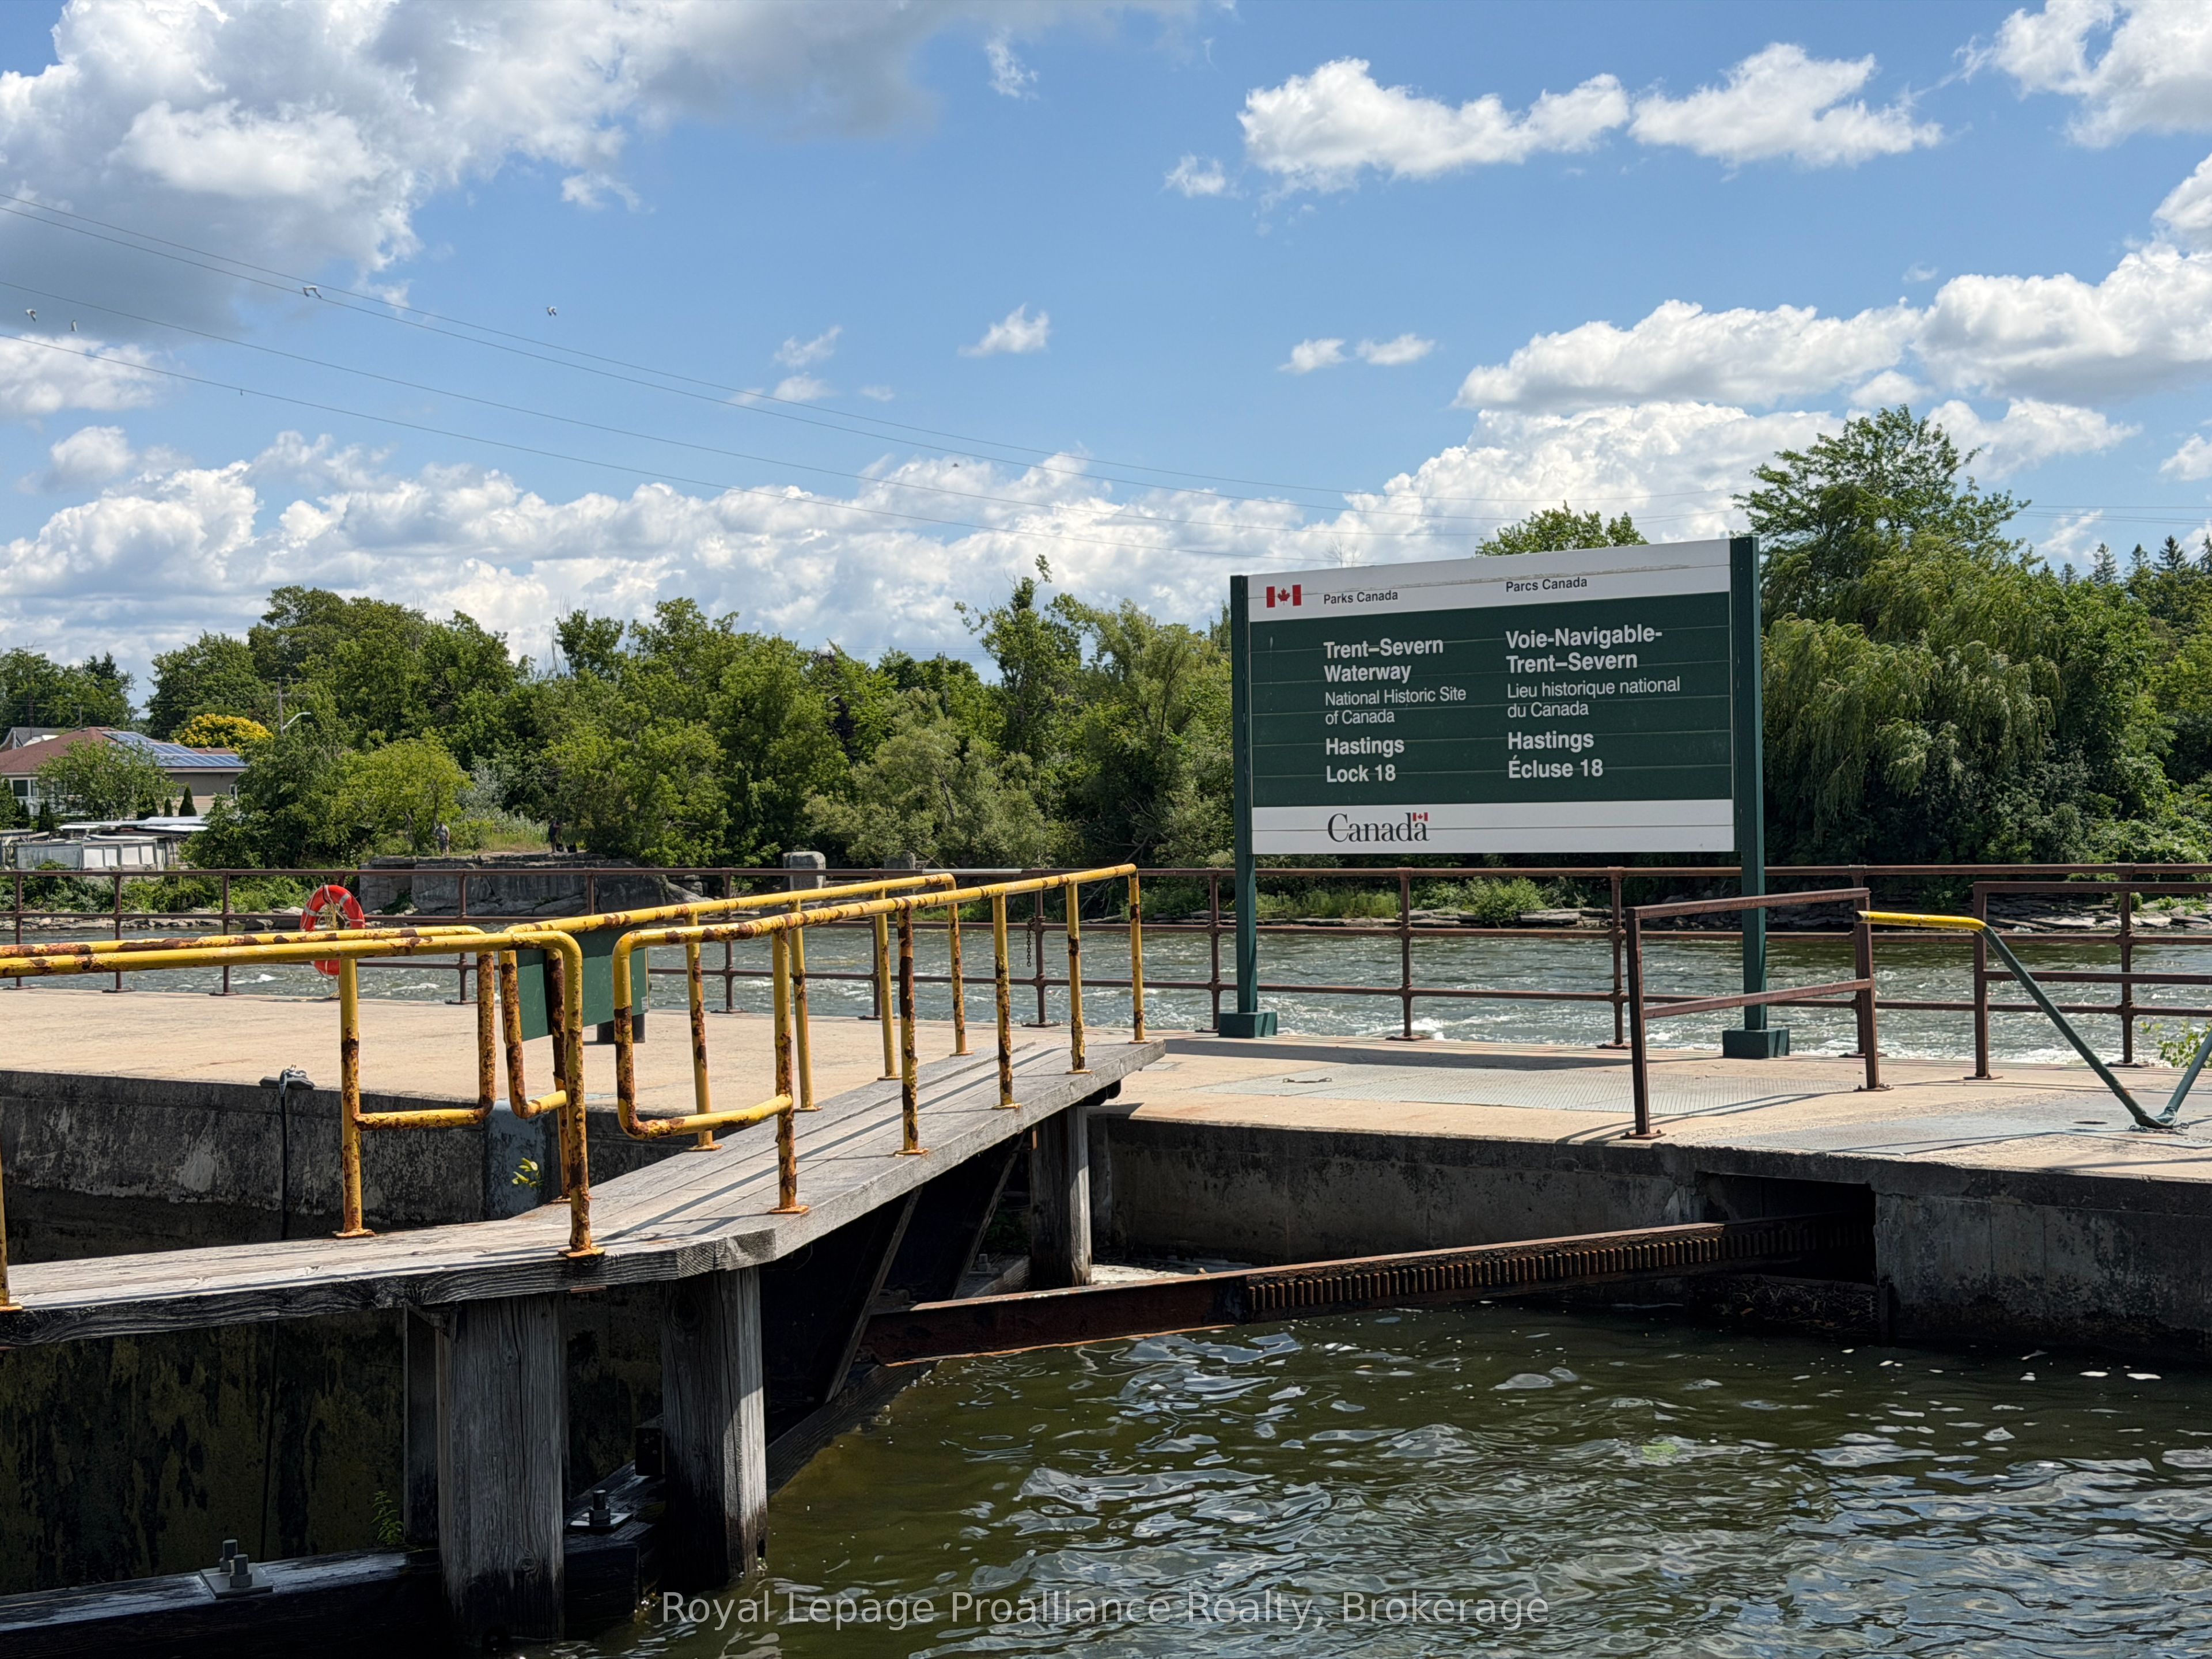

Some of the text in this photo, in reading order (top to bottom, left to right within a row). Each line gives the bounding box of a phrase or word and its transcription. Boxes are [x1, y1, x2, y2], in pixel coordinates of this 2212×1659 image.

[1506, 577, 1588, 592] Parcs Canada
[1324, 590, 1398, 604] Parks Canada
[1506, 624, 1662, 649] Voie-Navigable-
[1324, 665, 1411, 684] Waterway
[1325, 686, 1466, 706] National Historic Site
[1508, 676, 1680, 699] Lieu historique national
[1325, 709, 1395, 725] of Canada
[1508, 701, 1589, 718] du Canada
[1325, 737, 1404, 757] Hastings
[1508, 730, 1594, 753] Hastings
[1326, 764, 1396, 782] Lock 18
[1508, 755, 1603, 778] Écluse 18
[1328, 812, 1430, 842] Canada
